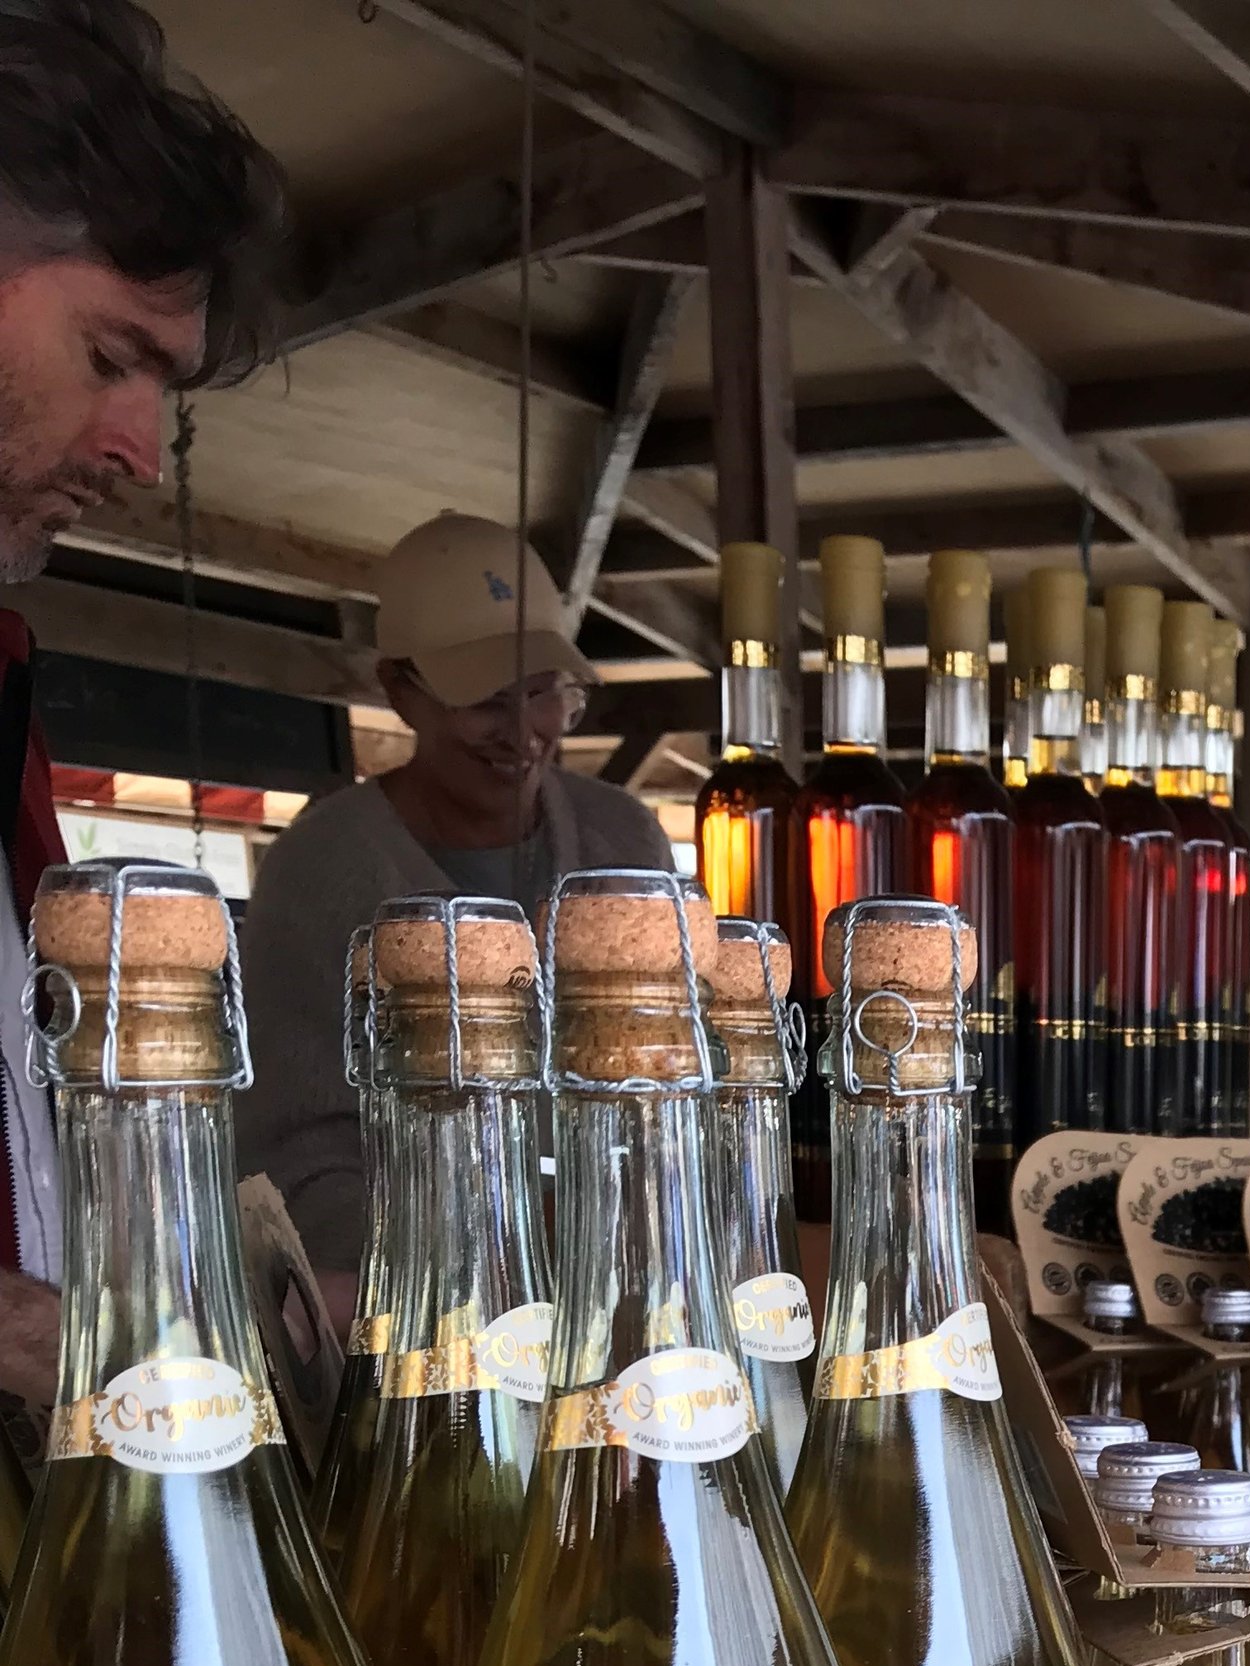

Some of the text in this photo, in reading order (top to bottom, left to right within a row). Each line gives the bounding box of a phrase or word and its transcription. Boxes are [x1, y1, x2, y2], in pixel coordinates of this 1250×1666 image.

[119, 1433, 246, 1463] AWARD WINNING WINERY
[632, 1424, 743, 1451] AWARD WINNING WINERY
